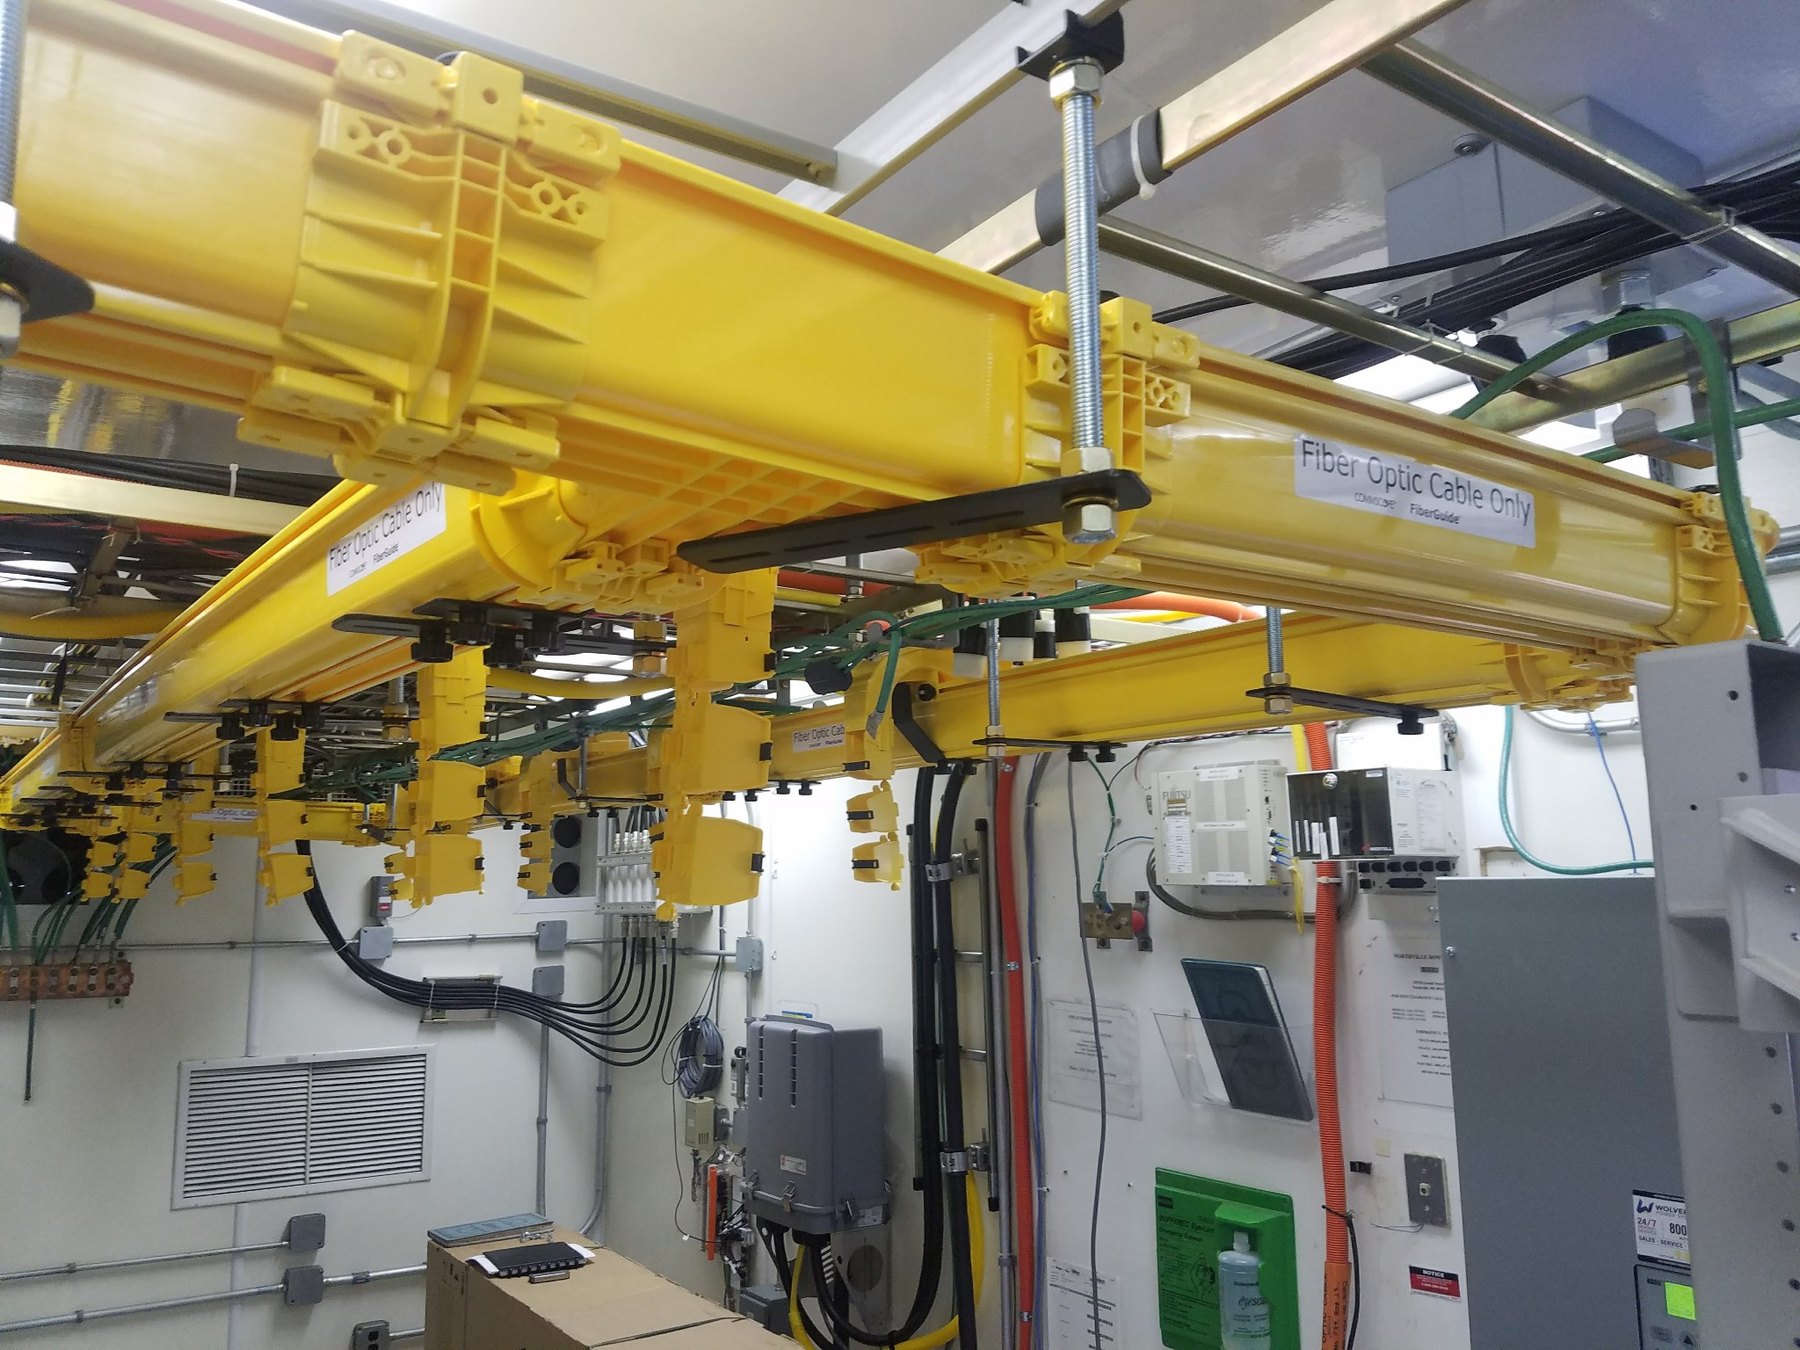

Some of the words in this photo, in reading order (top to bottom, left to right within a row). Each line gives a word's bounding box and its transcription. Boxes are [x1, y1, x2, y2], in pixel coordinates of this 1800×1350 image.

[1302, 439, 1359, 478] Fiber
[1368, 456, 1423, 494] Optic
[1430, 472, 1484, 509] Cable
[1490, 488, 1531, 527] Only
[1410, 502, 1460, 526] FiberGuide
[329, 543, 352, 571] Fiber
[354, 523, 379, 558] Optic
[382, 502, 411, 538] Cable
[415, 481, 442, 517] Only
[794, 732, 811, 743] Fiber
[812, 728, 830, 741] Optic
[1637, 1217, 1656, 1228] 24/7
[1669, 1222, 1687, 1236] 800
[1639, 1235, 1656, 1243] SALES
[1660, 1239, 1684, 1249] SERVICE
[1423, 1269, 1445, 1277] NOTICE
